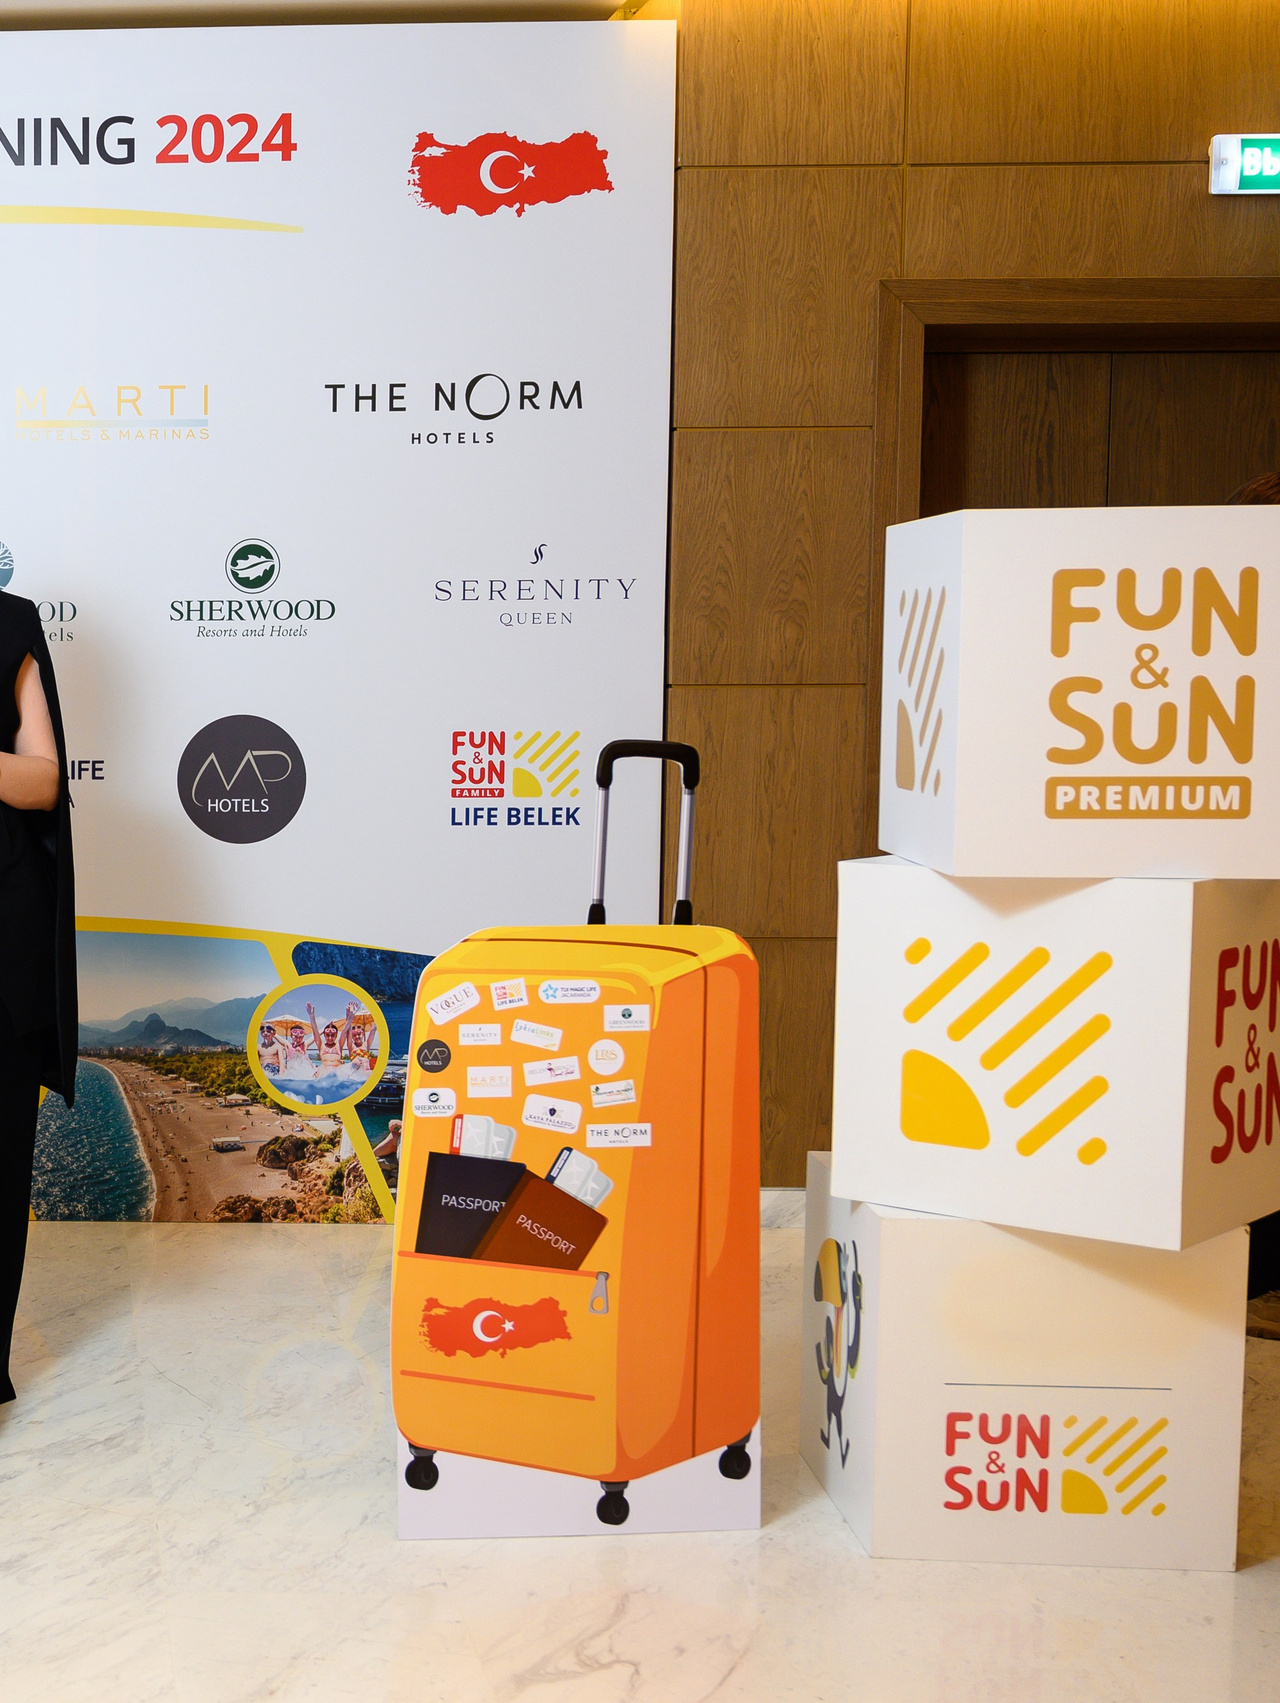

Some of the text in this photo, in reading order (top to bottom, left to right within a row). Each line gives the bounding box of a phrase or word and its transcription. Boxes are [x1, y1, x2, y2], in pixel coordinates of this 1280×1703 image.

[155, 112, 298, 164] 2024
[15, 384, 209, 417] MARTI
[324, 373, 583, 421] THE NORM
[15, 428, 210, 441] HOTELS & MARINAS
[411, 432, 495, 444] HOTELS
[434, 578, 637, 602] SERENITY
[169, 599, 336, 622] SHERWOOD
[499, 612, 573, 627] QUEEN
[1050, 566, 1260, 658] FUN
[196, 624, 308, 638] Resorts and Hotels
[1130, 643, 1170, 690] &
[452, 731, 506, 756] FUN
[472, 751, 483, 764] &
[68, 760, 105, 780] IFE
[455, 789, 501, 797] FAMILY
[1055, 785, 1241, 811] PREMIUM
[208, 798, 270, 813] HOTELS
[451, 806, 581, 826] LIFE BELEK
[430, 986, 474, 1015] VOGUE
[614, 1126, 648, 1138] NORM
[515, 1214, 577, 1256] PASSPORT
[945, 1412, 1051, 1459] FUN
[986, 1451, 1006, 1474] &
